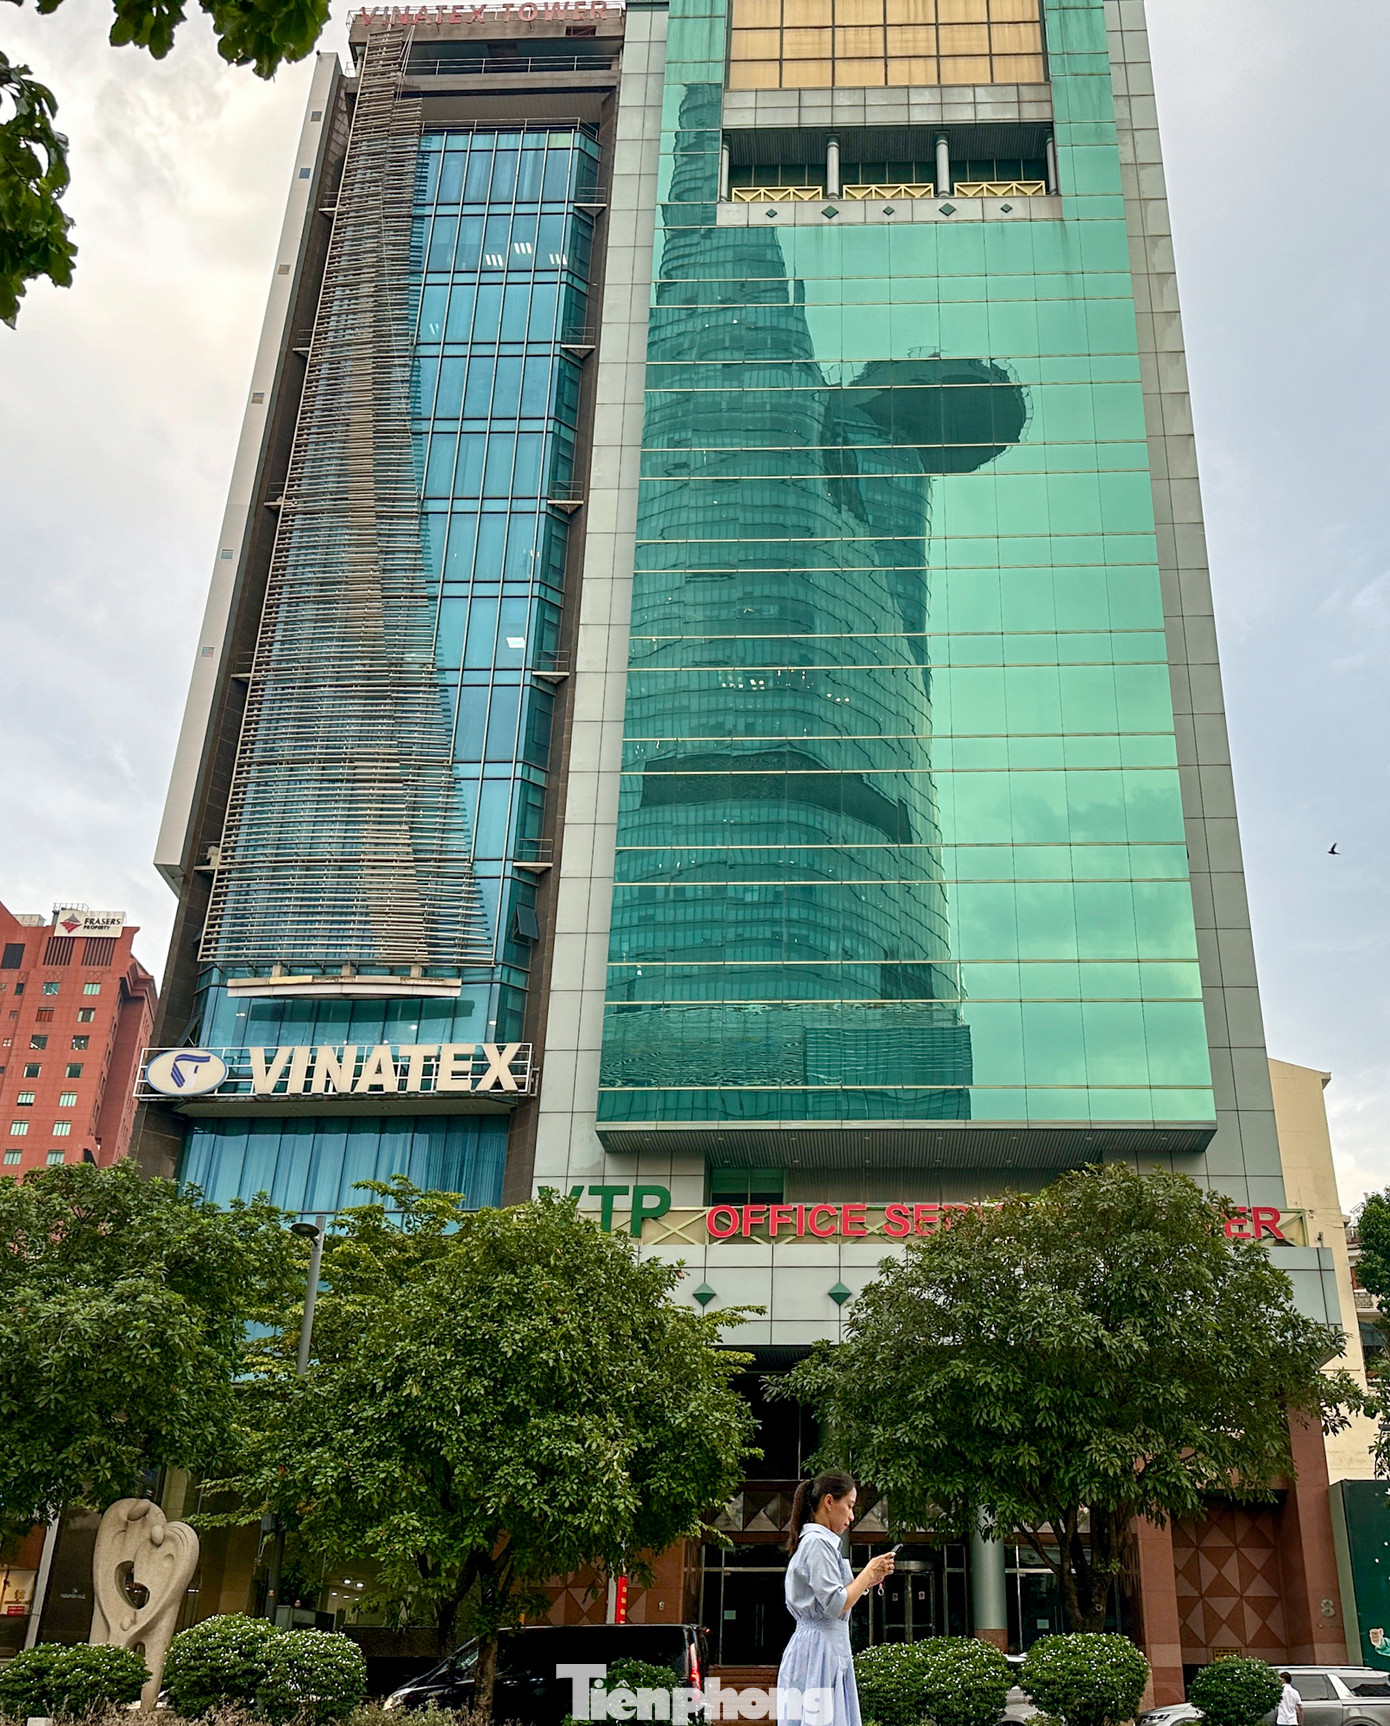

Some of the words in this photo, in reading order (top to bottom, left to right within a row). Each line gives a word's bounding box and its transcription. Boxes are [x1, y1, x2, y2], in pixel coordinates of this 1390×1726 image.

[360, 4, 488, 26] VINATEX
[502, 1, 608, 23] TOWER
[249, 1043, 522, 1095] VINATEX
[706, 1203, 868, 1238] OFFICE
